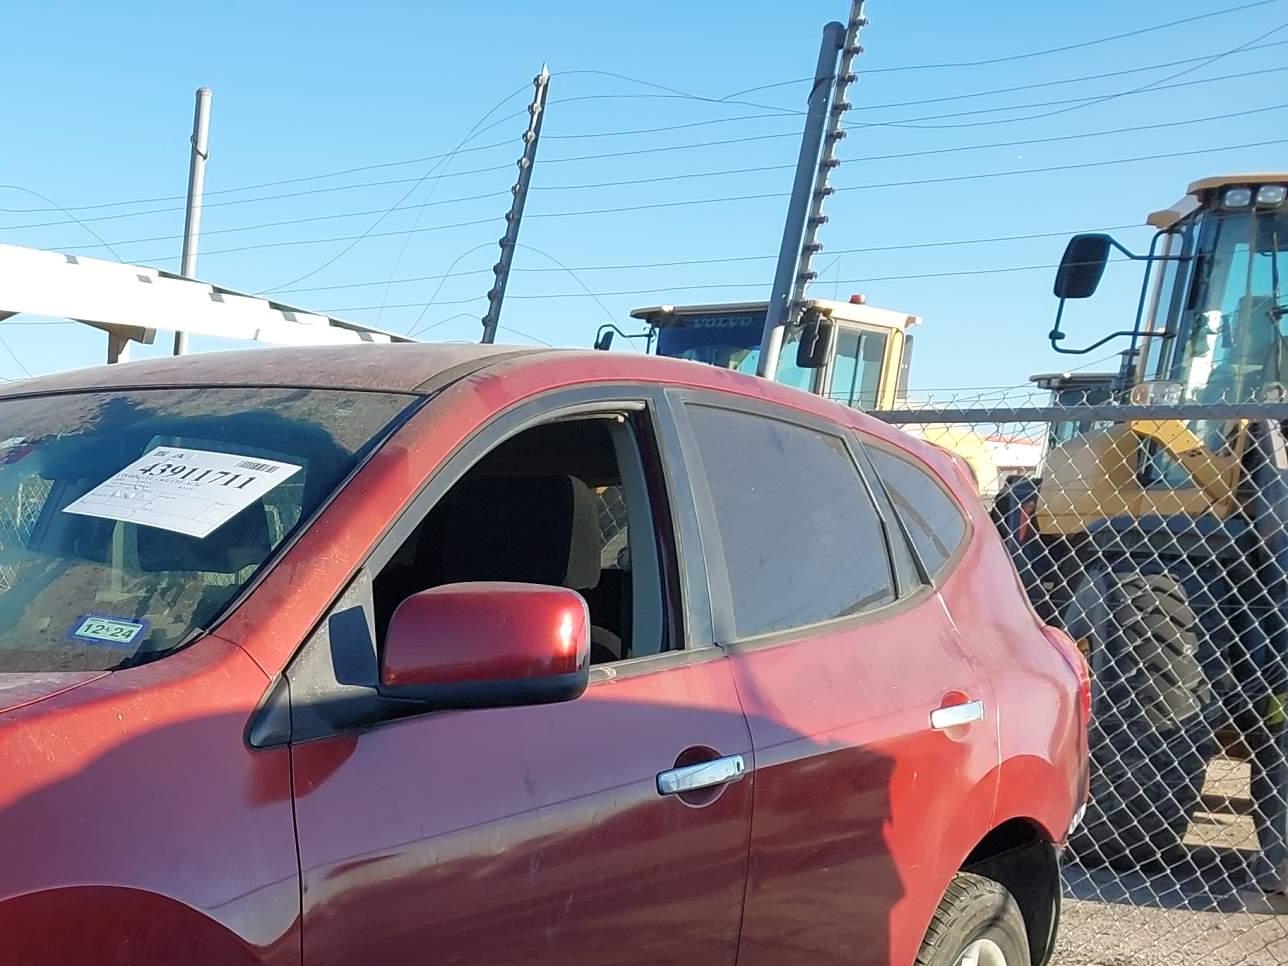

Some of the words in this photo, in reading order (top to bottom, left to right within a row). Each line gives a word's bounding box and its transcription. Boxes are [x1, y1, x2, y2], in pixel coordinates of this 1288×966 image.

[692, 316, 753, 329] VOLVO
[138, 461, 257, 490] 43911711
[84, 623, 105, 635] 12
[109, 627, 134, 639] 24
